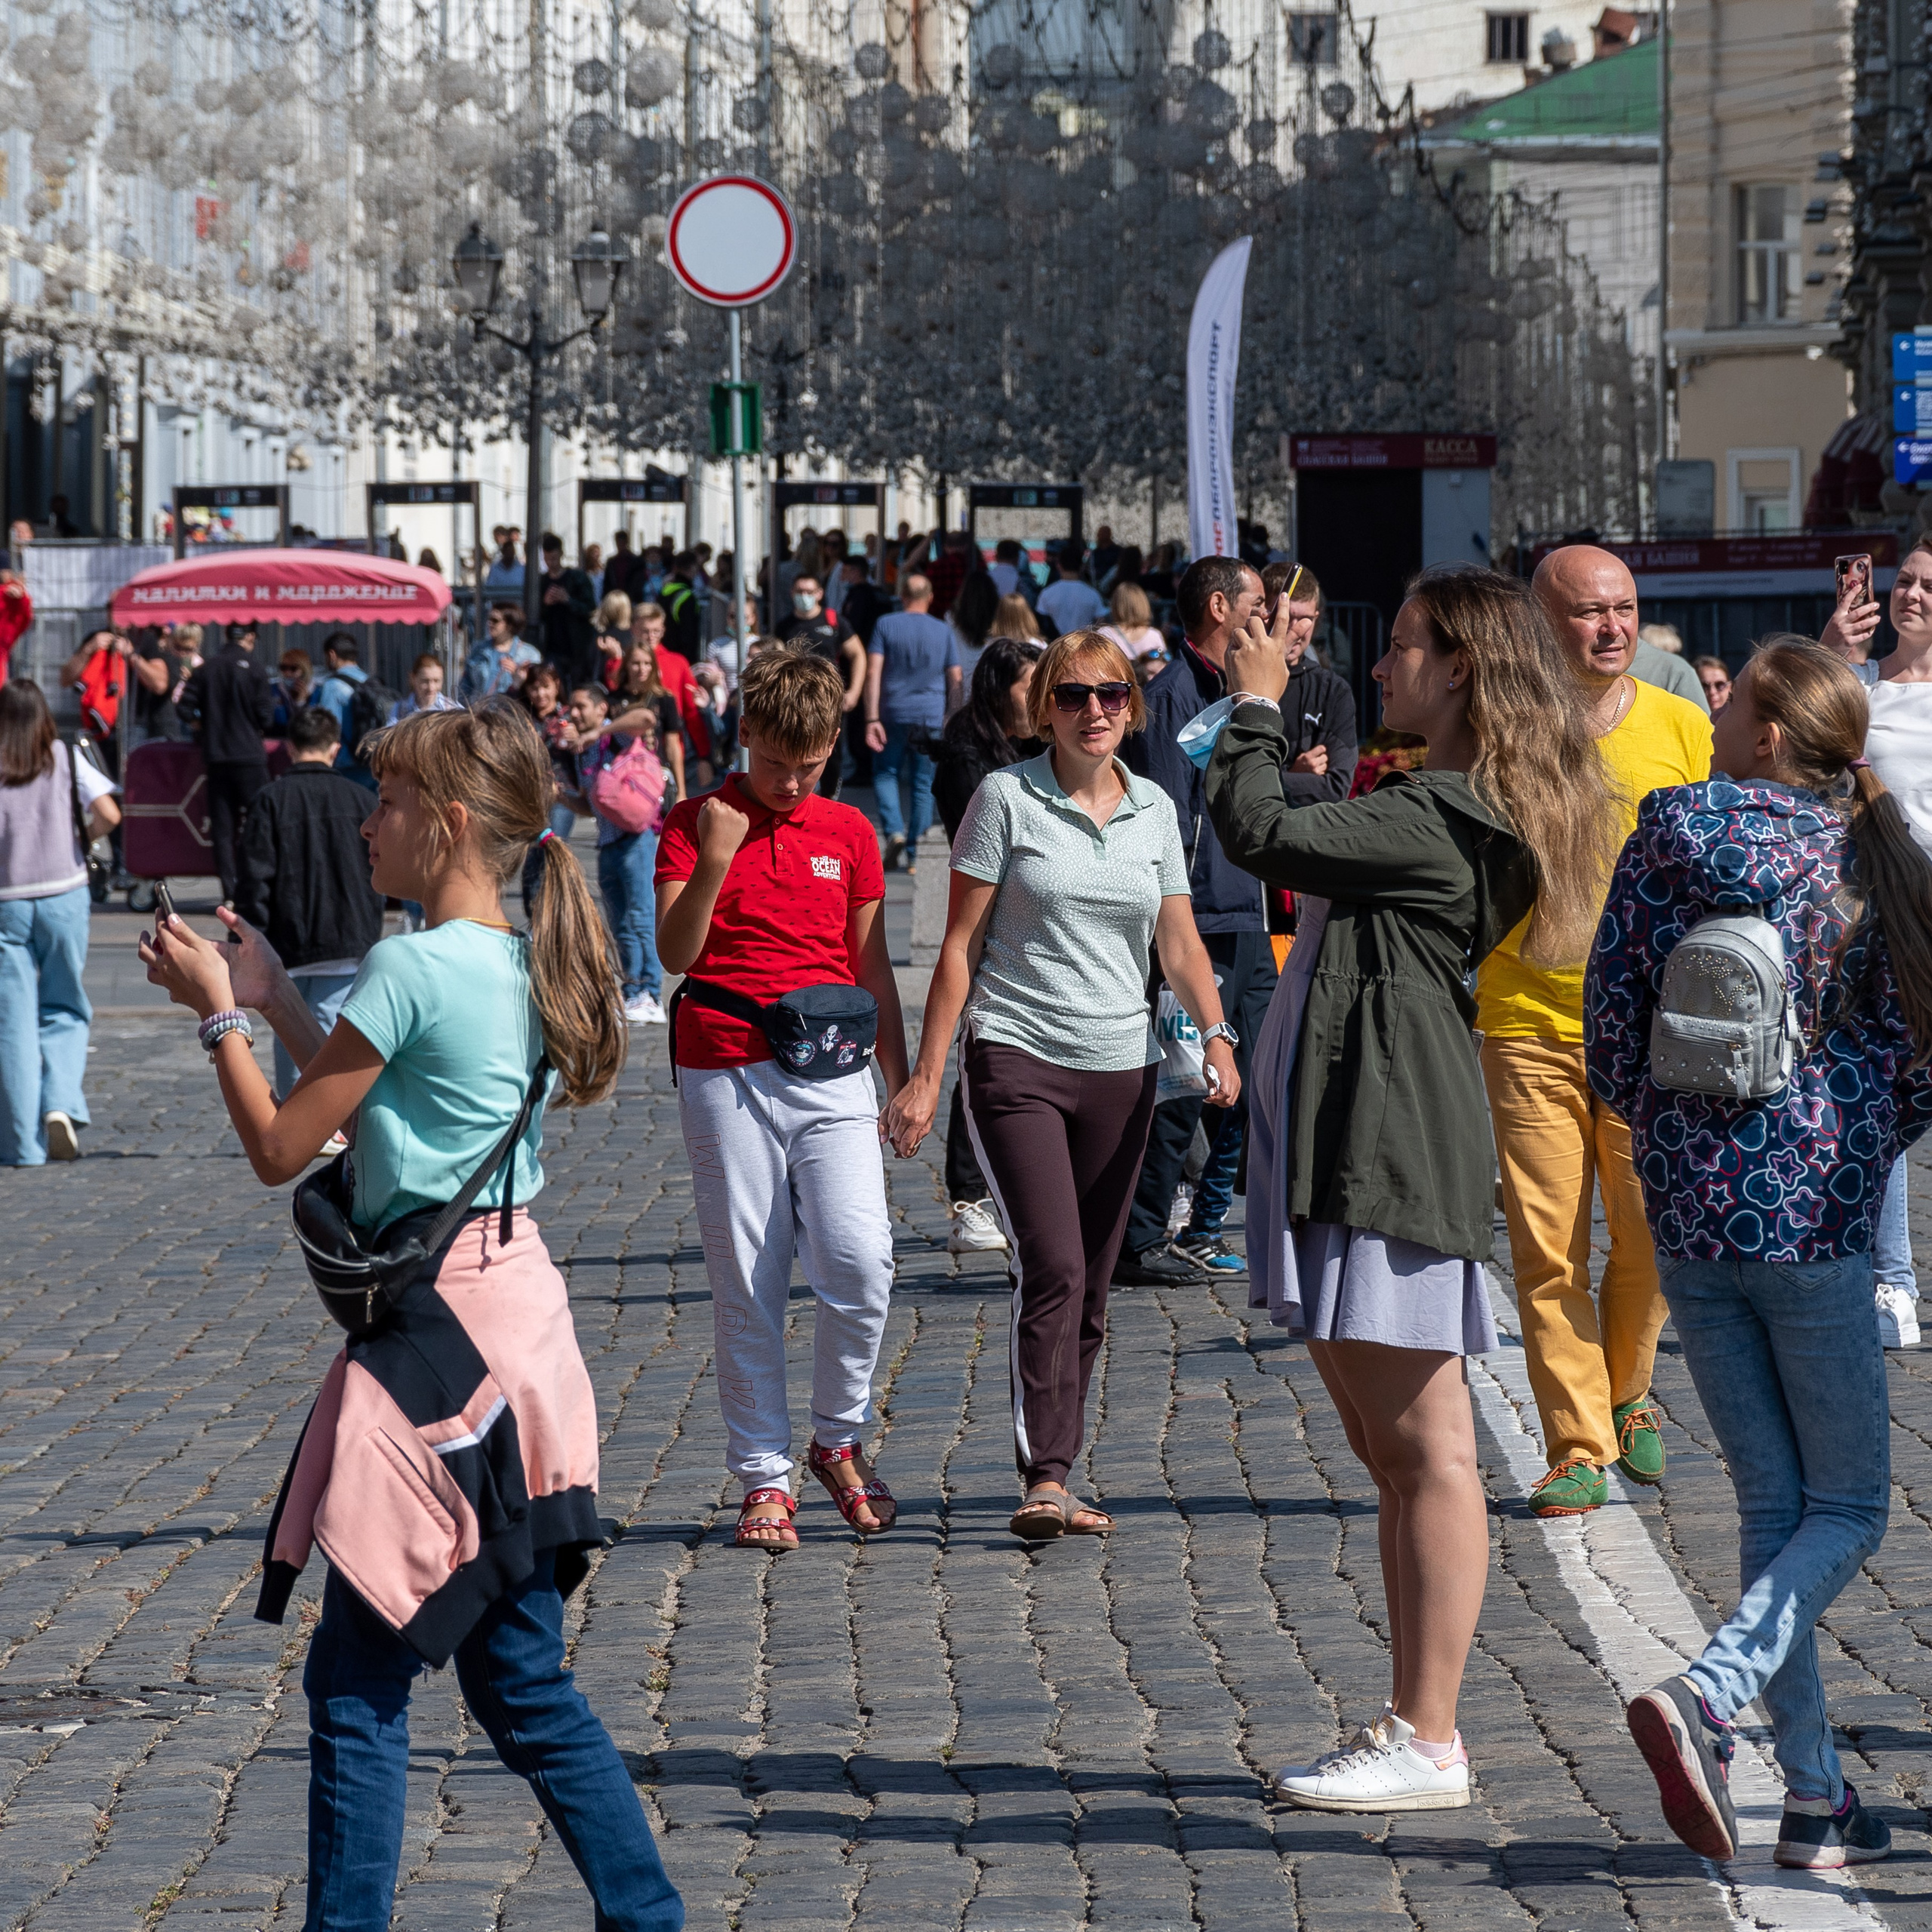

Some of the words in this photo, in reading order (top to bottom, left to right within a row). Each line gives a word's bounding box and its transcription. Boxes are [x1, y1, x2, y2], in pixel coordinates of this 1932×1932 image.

[1208, 319, 1223, 556] ОСОБОРОНЭКСПОРТ
[1424, 438, 1478, 453] КАССА
[811, 860, 841, 875] OCEAN
[813, 872, 841, 880] ADVENTURES
